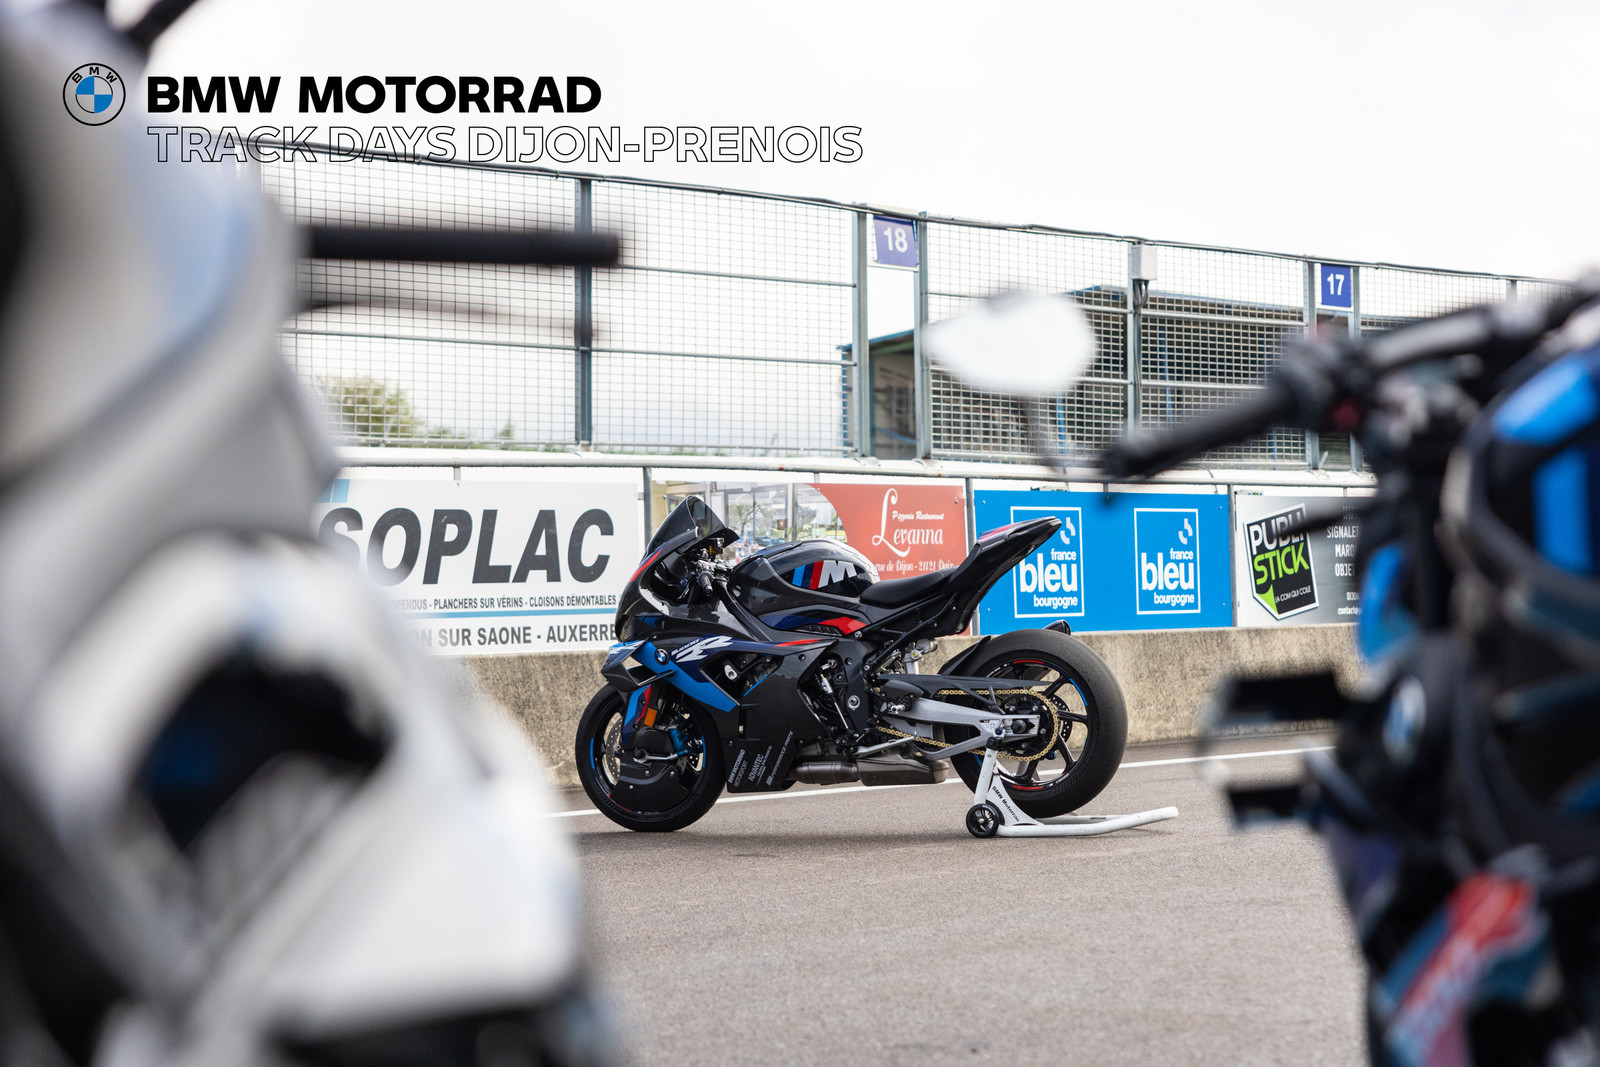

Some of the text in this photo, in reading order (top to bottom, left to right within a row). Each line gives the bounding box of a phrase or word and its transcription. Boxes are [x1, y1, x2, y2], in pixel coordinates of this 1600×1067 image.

[883, 226, 908, 253] 18
[1327, 273, 1345, 296] 17
[871, 488, 944, 557] Levanna
[318, 507, 614, 586] SOPLAC
[1051, 548, 1077, 562] france
[1170, 548, 1194, 560] france
[886, 560, 895, 571] de
[896, 560, 914, 575] Dijon
[1019, 552, 1078, 593] bleu
[1141, 552, 1195, 590] bleu
[1253, 541, 1310, 586] STICK
[433, 597, 478, 610] PLANCHERS
[480, 597, 495, 609] SUR
[497, 594, 523, 608] VÉRINS
[529, 596, 565, 607] CLOISONS
[567, 593, 617, 606] DÉMONTABLES
[1033, 594, 1078, 609] bourgogne
[1154, 592, 1195, 606] bourgogne
[438, 628, 472, 647] SUR
[477, 626, 532, 646] SAONE
[546, 624, 618, 643] AUXERRE
